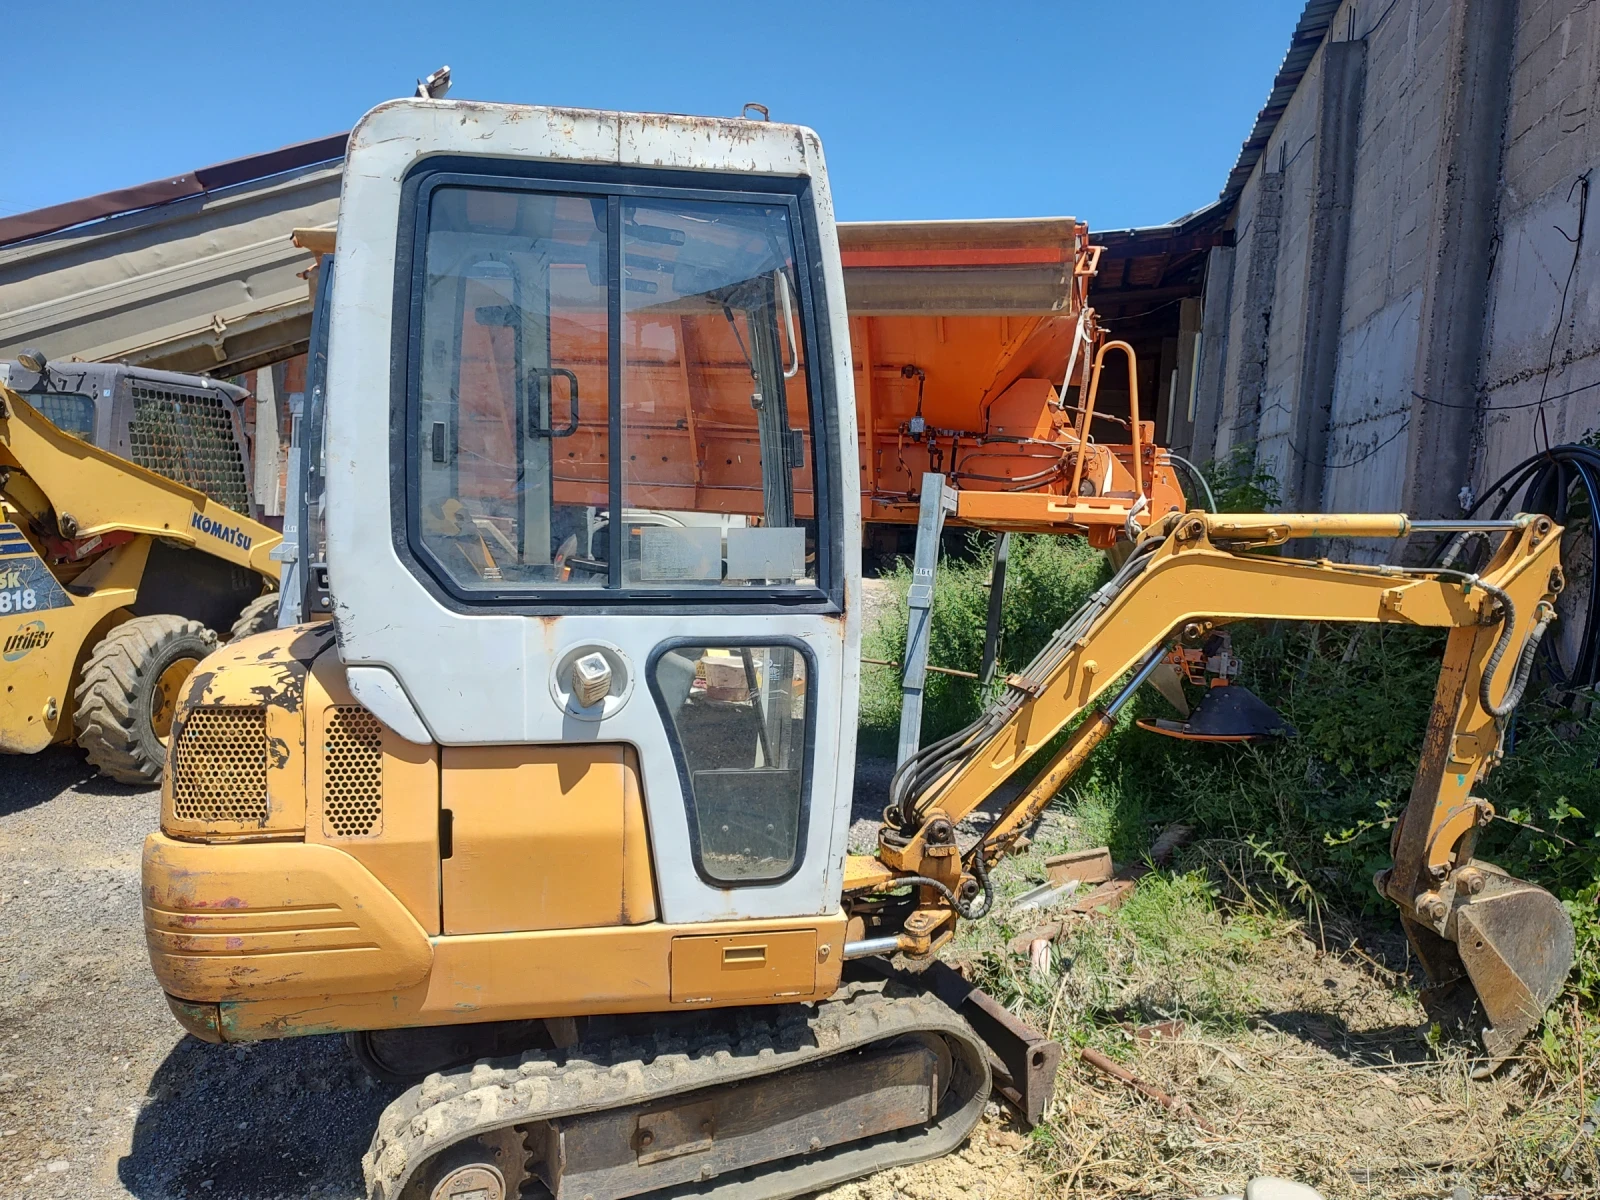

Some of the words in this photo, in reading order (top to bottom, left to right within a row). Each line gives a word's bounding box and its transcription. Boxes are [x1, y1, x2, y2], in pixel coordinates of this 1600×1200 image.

[191, 511, 252, 551] KOMATSU
[0, 571, 21, 590] SK
[0, 588, 37, 613] 818
[3, 630, 55, 653] Utility
